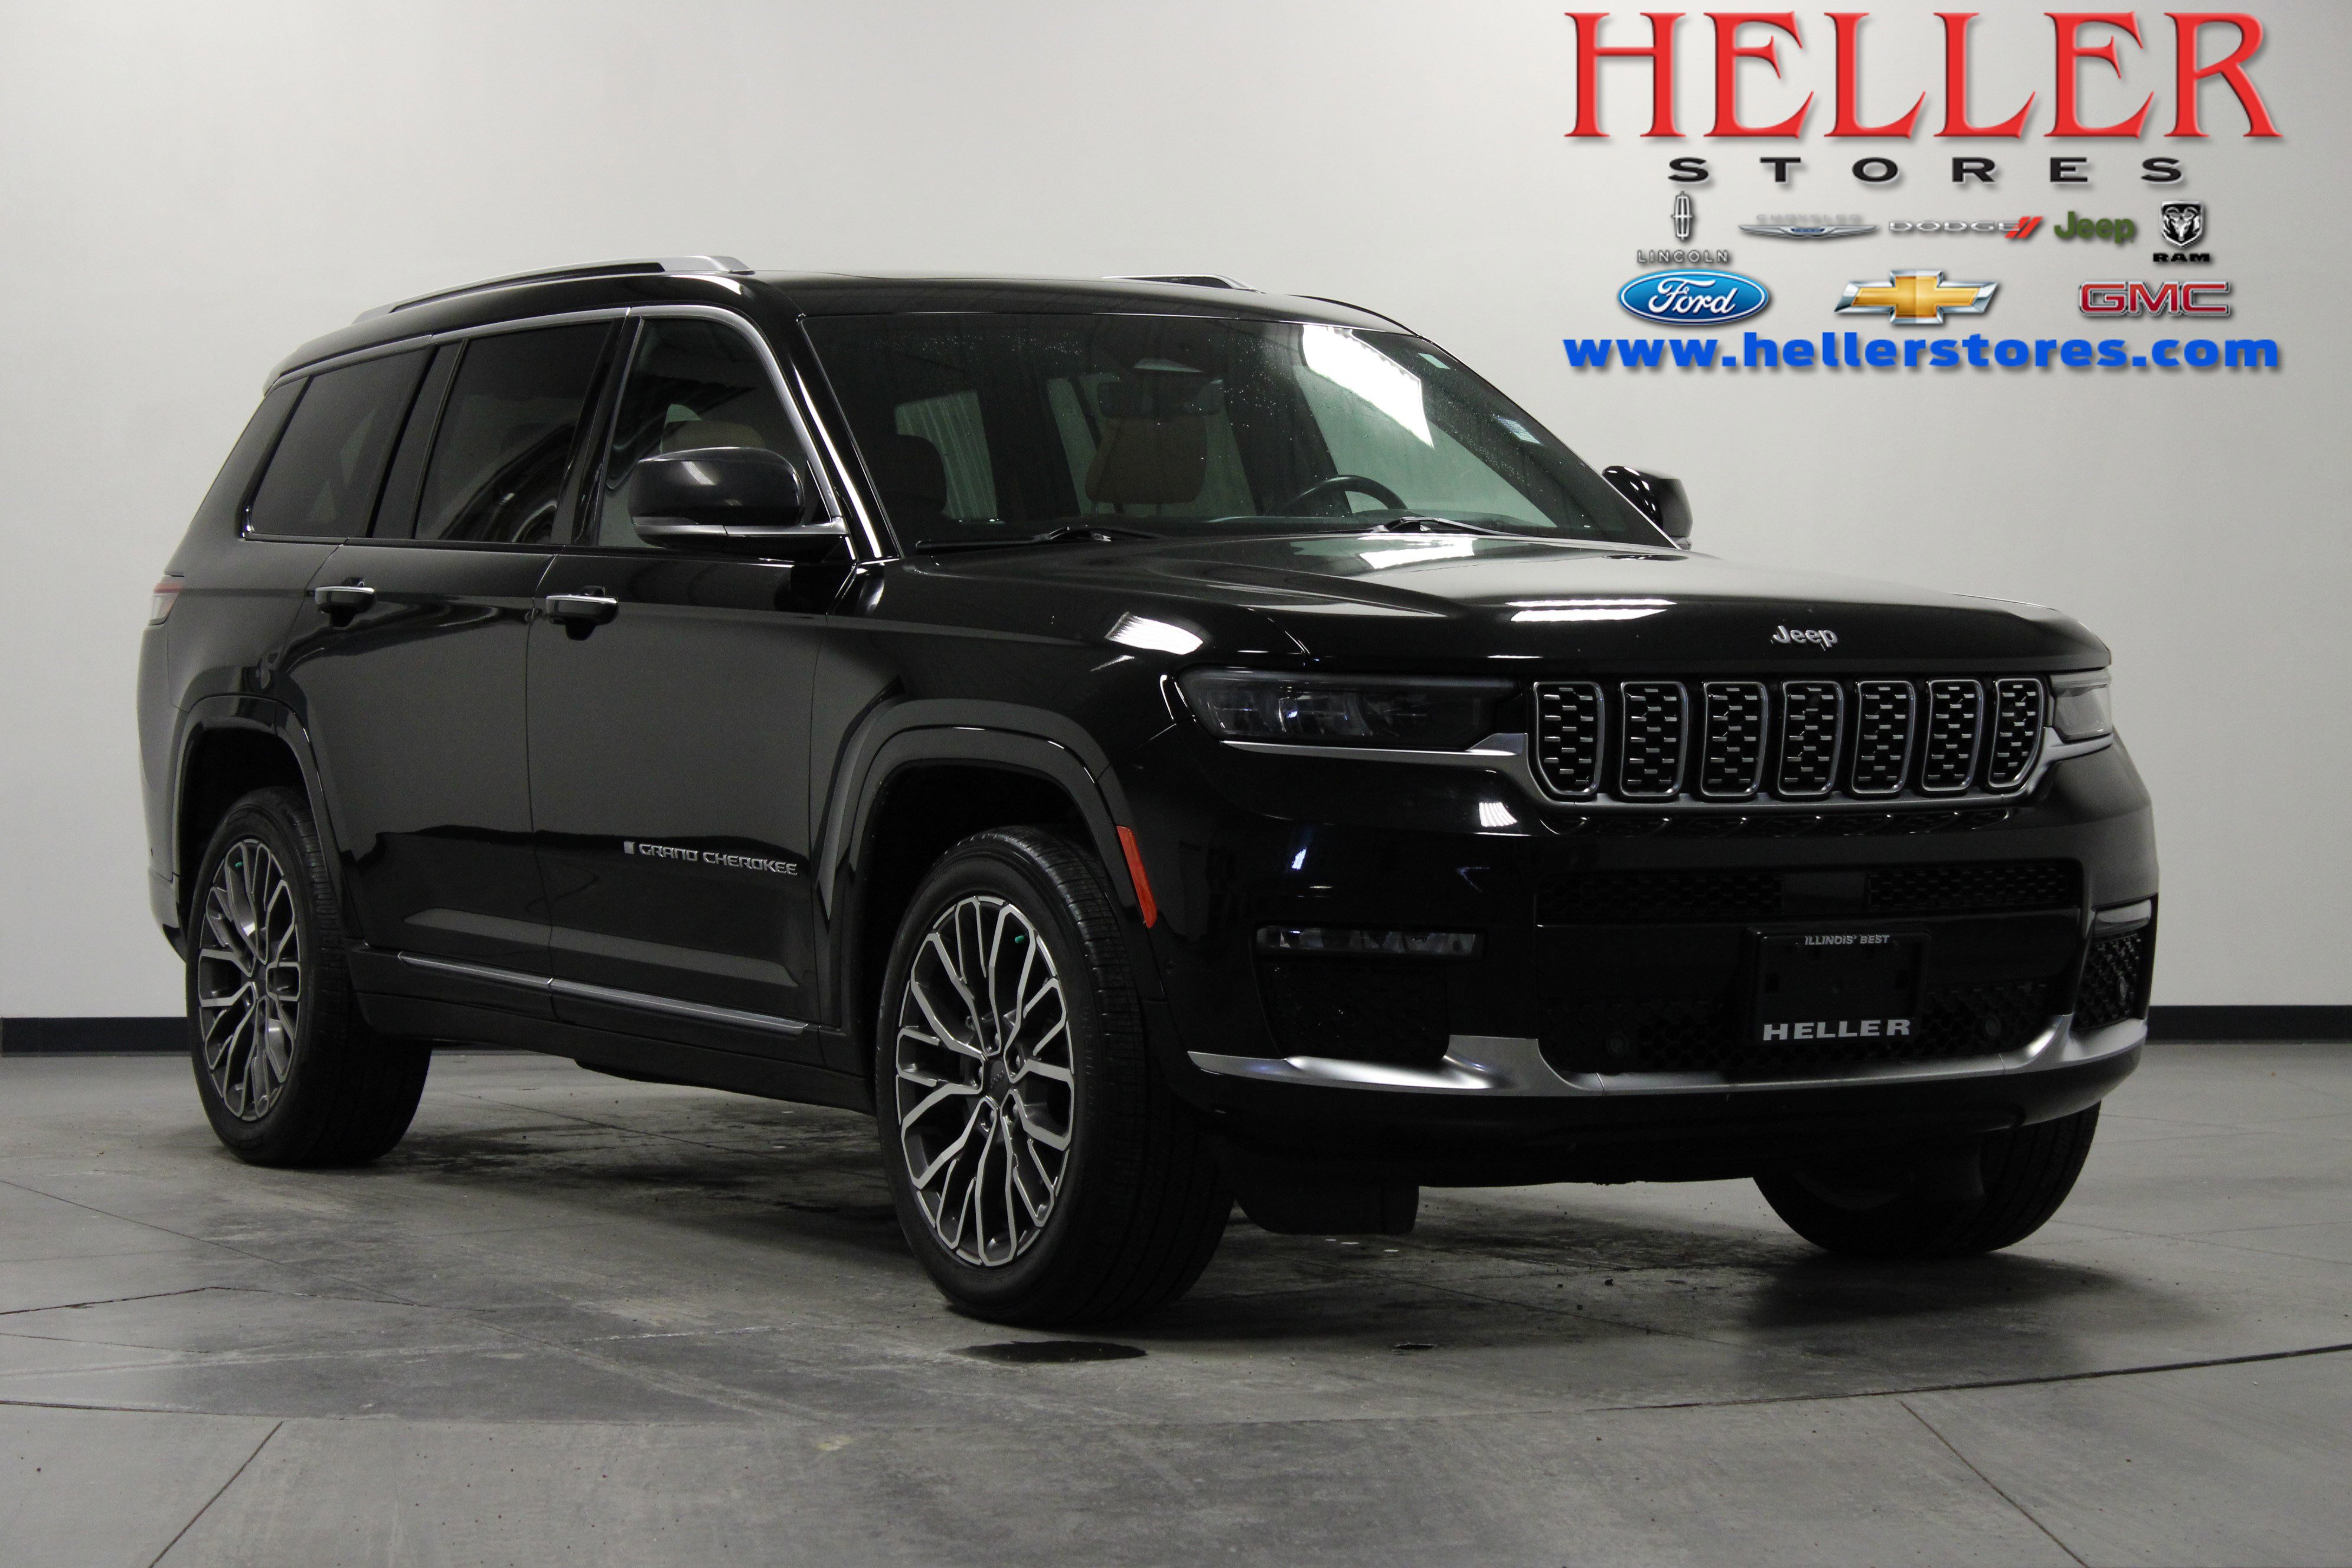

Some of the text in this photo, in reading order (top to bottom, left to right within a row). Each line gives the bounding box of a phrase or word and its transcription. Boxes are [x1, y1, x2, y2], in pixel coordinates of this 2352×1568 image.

[1772, 625, 1838, 648] Jeep
[639, 843, 798, 876] GRAND CHEROKEE
[1805, 935, 1890, 945] ILLINOIS' BEST
[1763, 1019, 1911, 1041] HELLER
